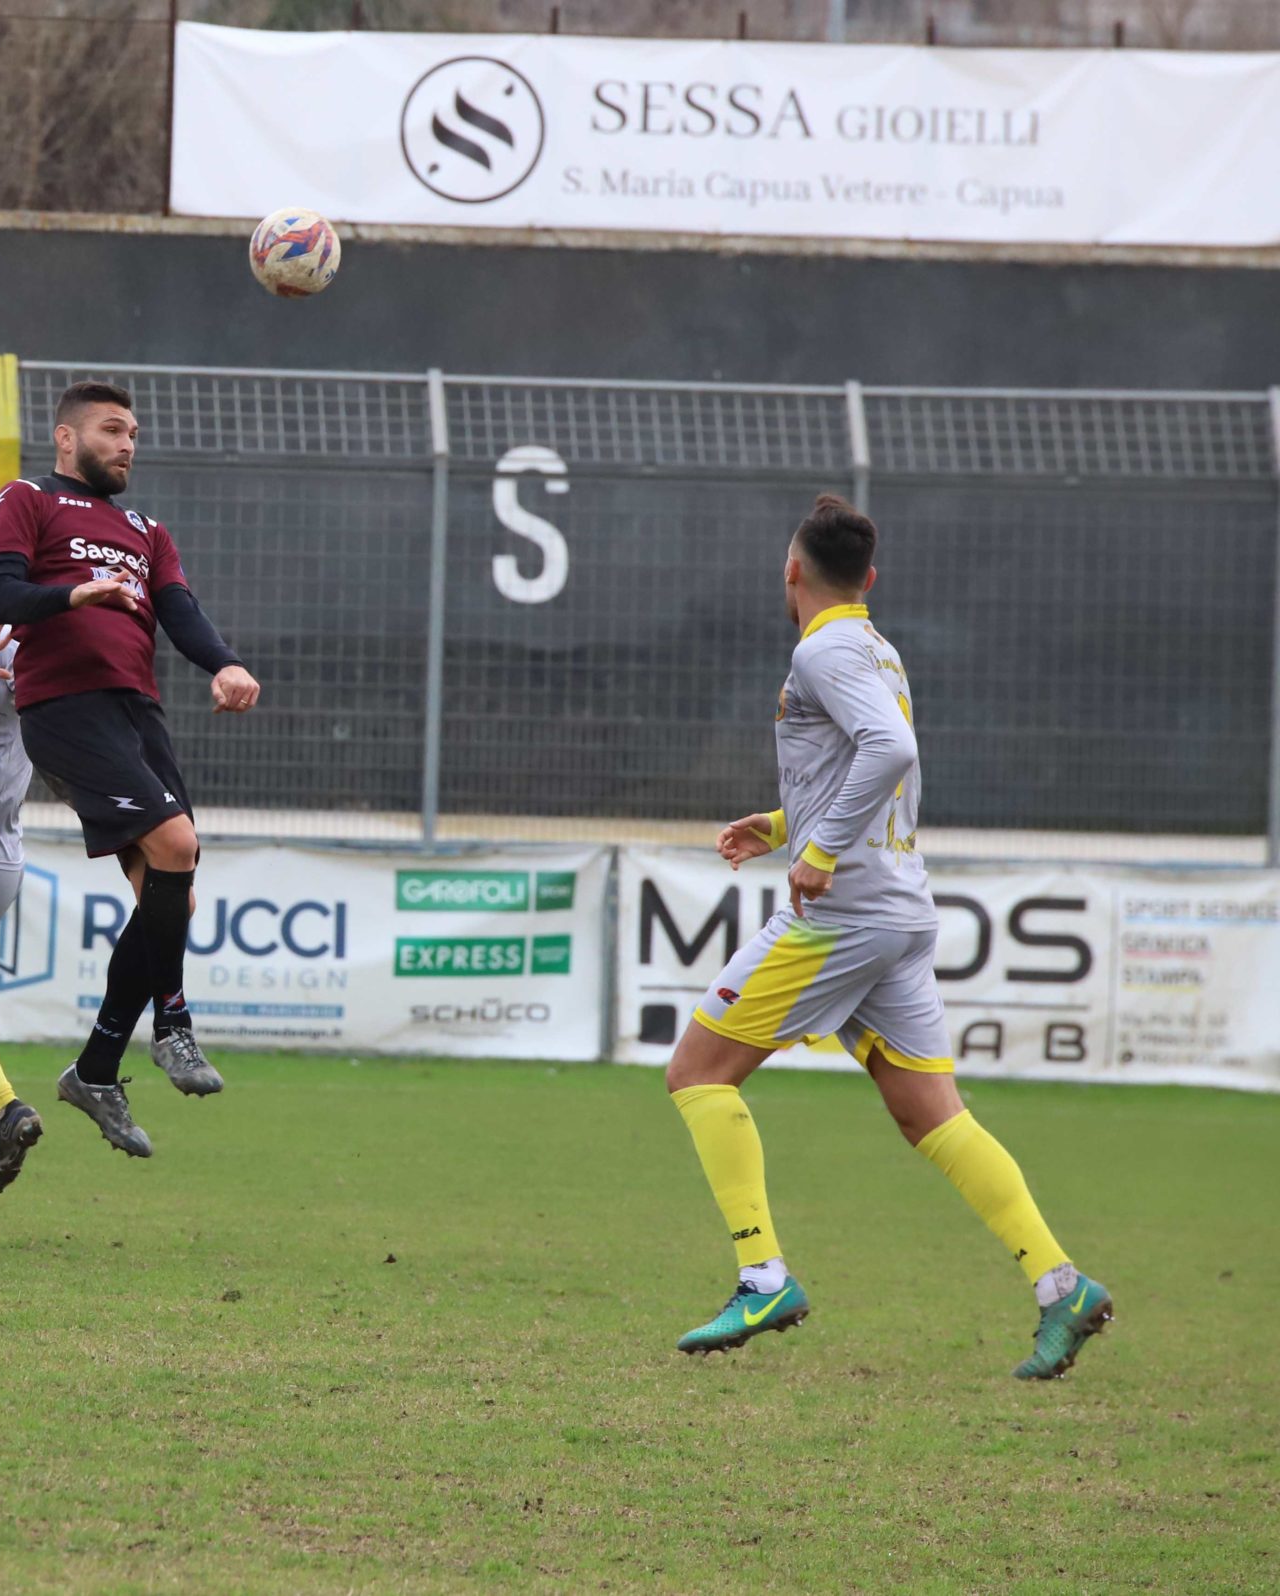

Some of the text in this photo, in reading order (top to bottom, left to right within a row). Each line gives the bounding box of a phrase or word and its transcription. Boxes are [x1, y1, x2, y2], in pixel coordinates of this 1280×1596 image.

[590, 80, 1042, 147] SESSA GIOIELLI
[561, 166, 590, 196] S.
[599, 168, 697, 200] Maria
[704, 171, 812, 209] Capua
[819, 173, 929, 203] Vetere
[955, 178, 1066, 216] Capua
[492, 445, 570, 604] S
[401, 878, 526, 905] GAROFOLI
[82, 893, 348, 959] RUCCI
[209, 964, 348, 989] DESIGN
[398, 944, 522, 971] EXPRESS
[410, 998, 552, 1023] SCHÜCO
